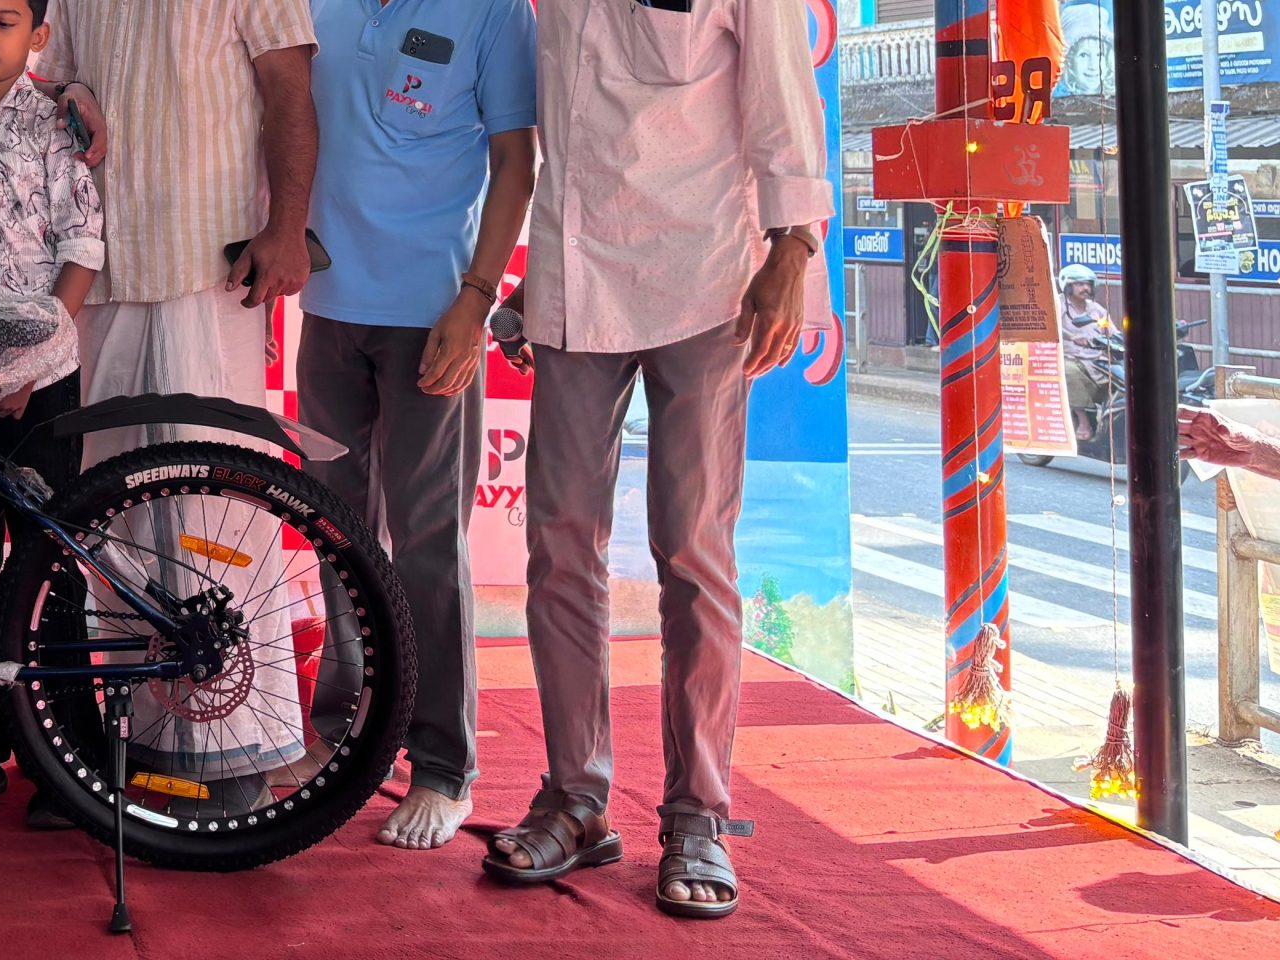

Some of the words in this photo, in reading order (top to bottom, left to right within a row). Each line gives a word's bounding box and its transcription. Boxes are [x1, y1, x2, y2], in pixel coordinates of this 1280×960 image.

[125, 464, 210, 489] SPEEDWAYS
[213, 467, 267, 491] BLACK
[266, 484, 316, 518] HAWK
